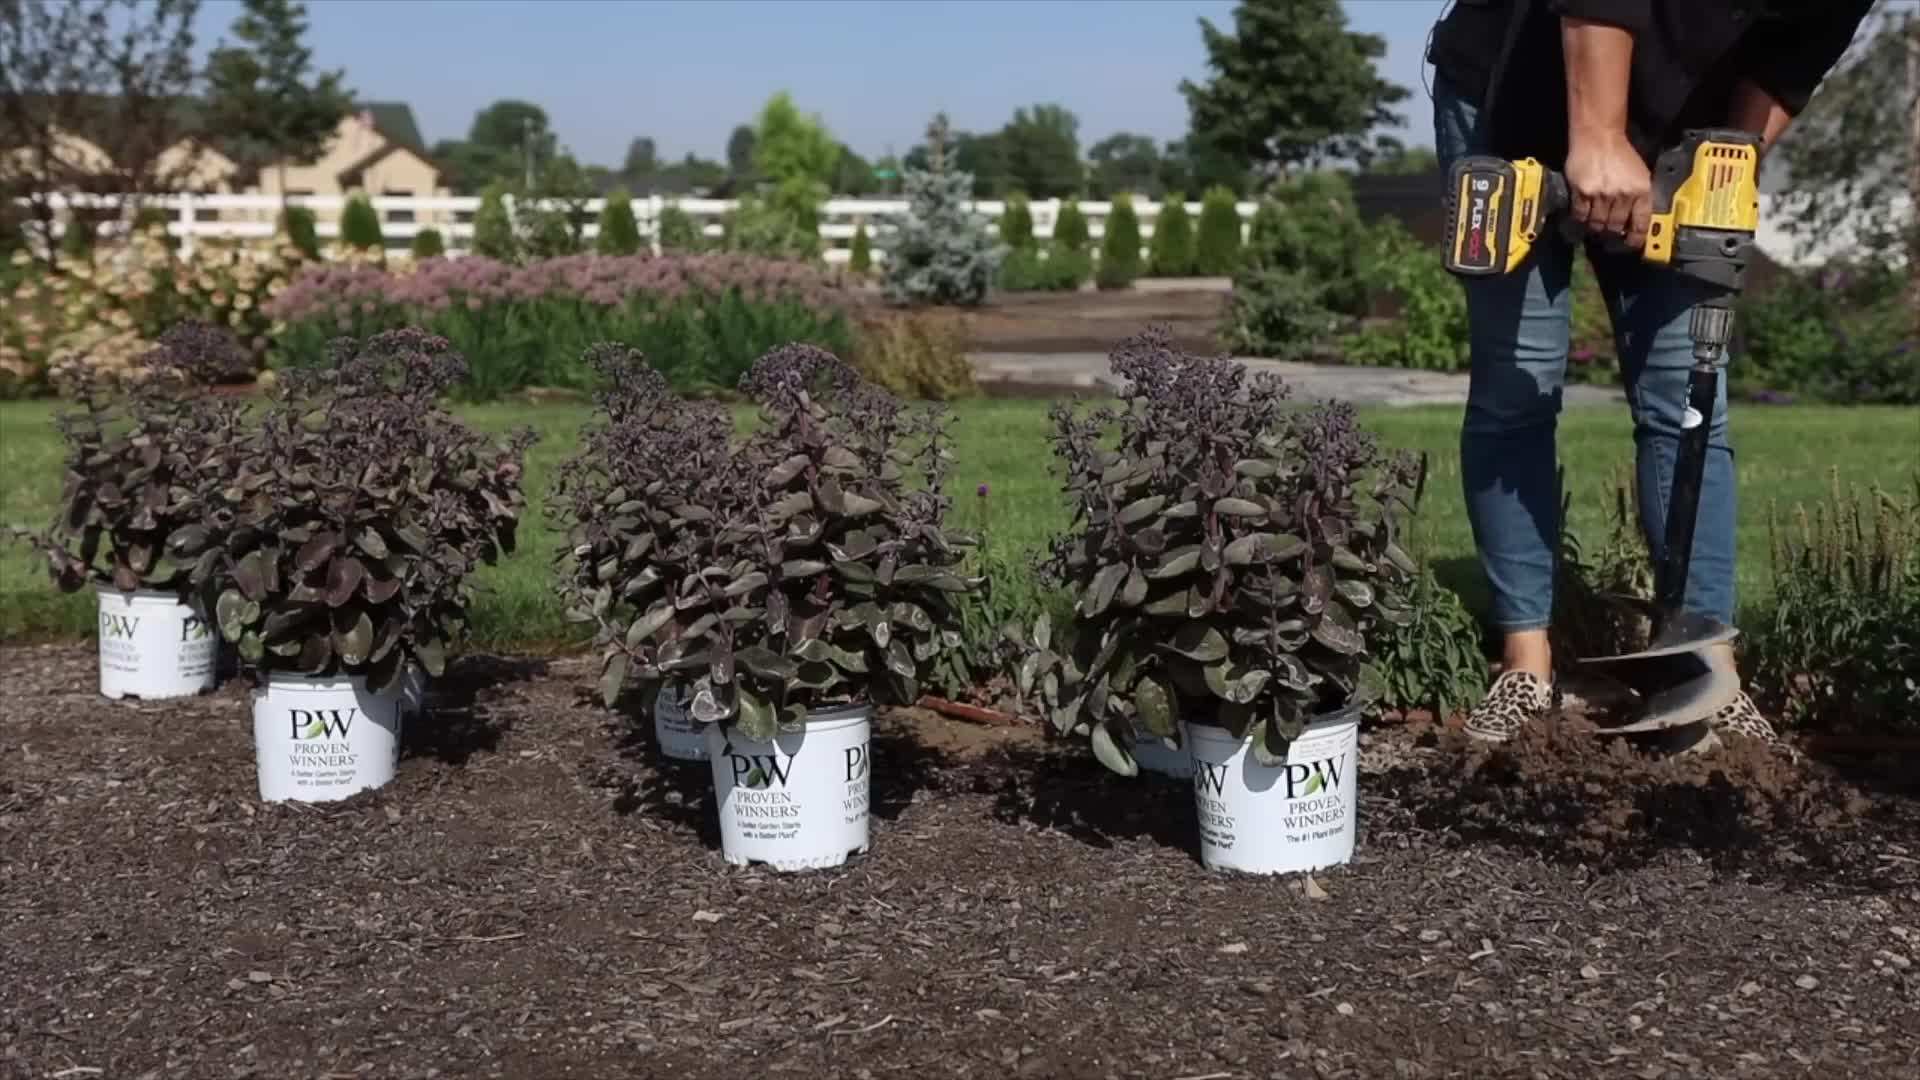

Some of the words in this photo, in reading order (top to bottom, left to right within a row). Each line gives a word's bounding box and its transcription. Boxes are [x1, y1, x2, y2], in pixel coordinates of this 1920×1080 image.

[1476, 179, 1489, 191] 9
[287, 707, 358, 740] PW
[294, 743, 350, 754] PROVEN
[730, 753, 794, 788] PW
[1280, 753, 1346, 800] PW
[736, 791, 792, 804] PROVEN
[1289, 794, 1343, 815] PROVEN
[1286, 834, 1300, 843] The
[1302, 832, 1311, 842] #1
[1312, 830, 1328, 841] Plant
